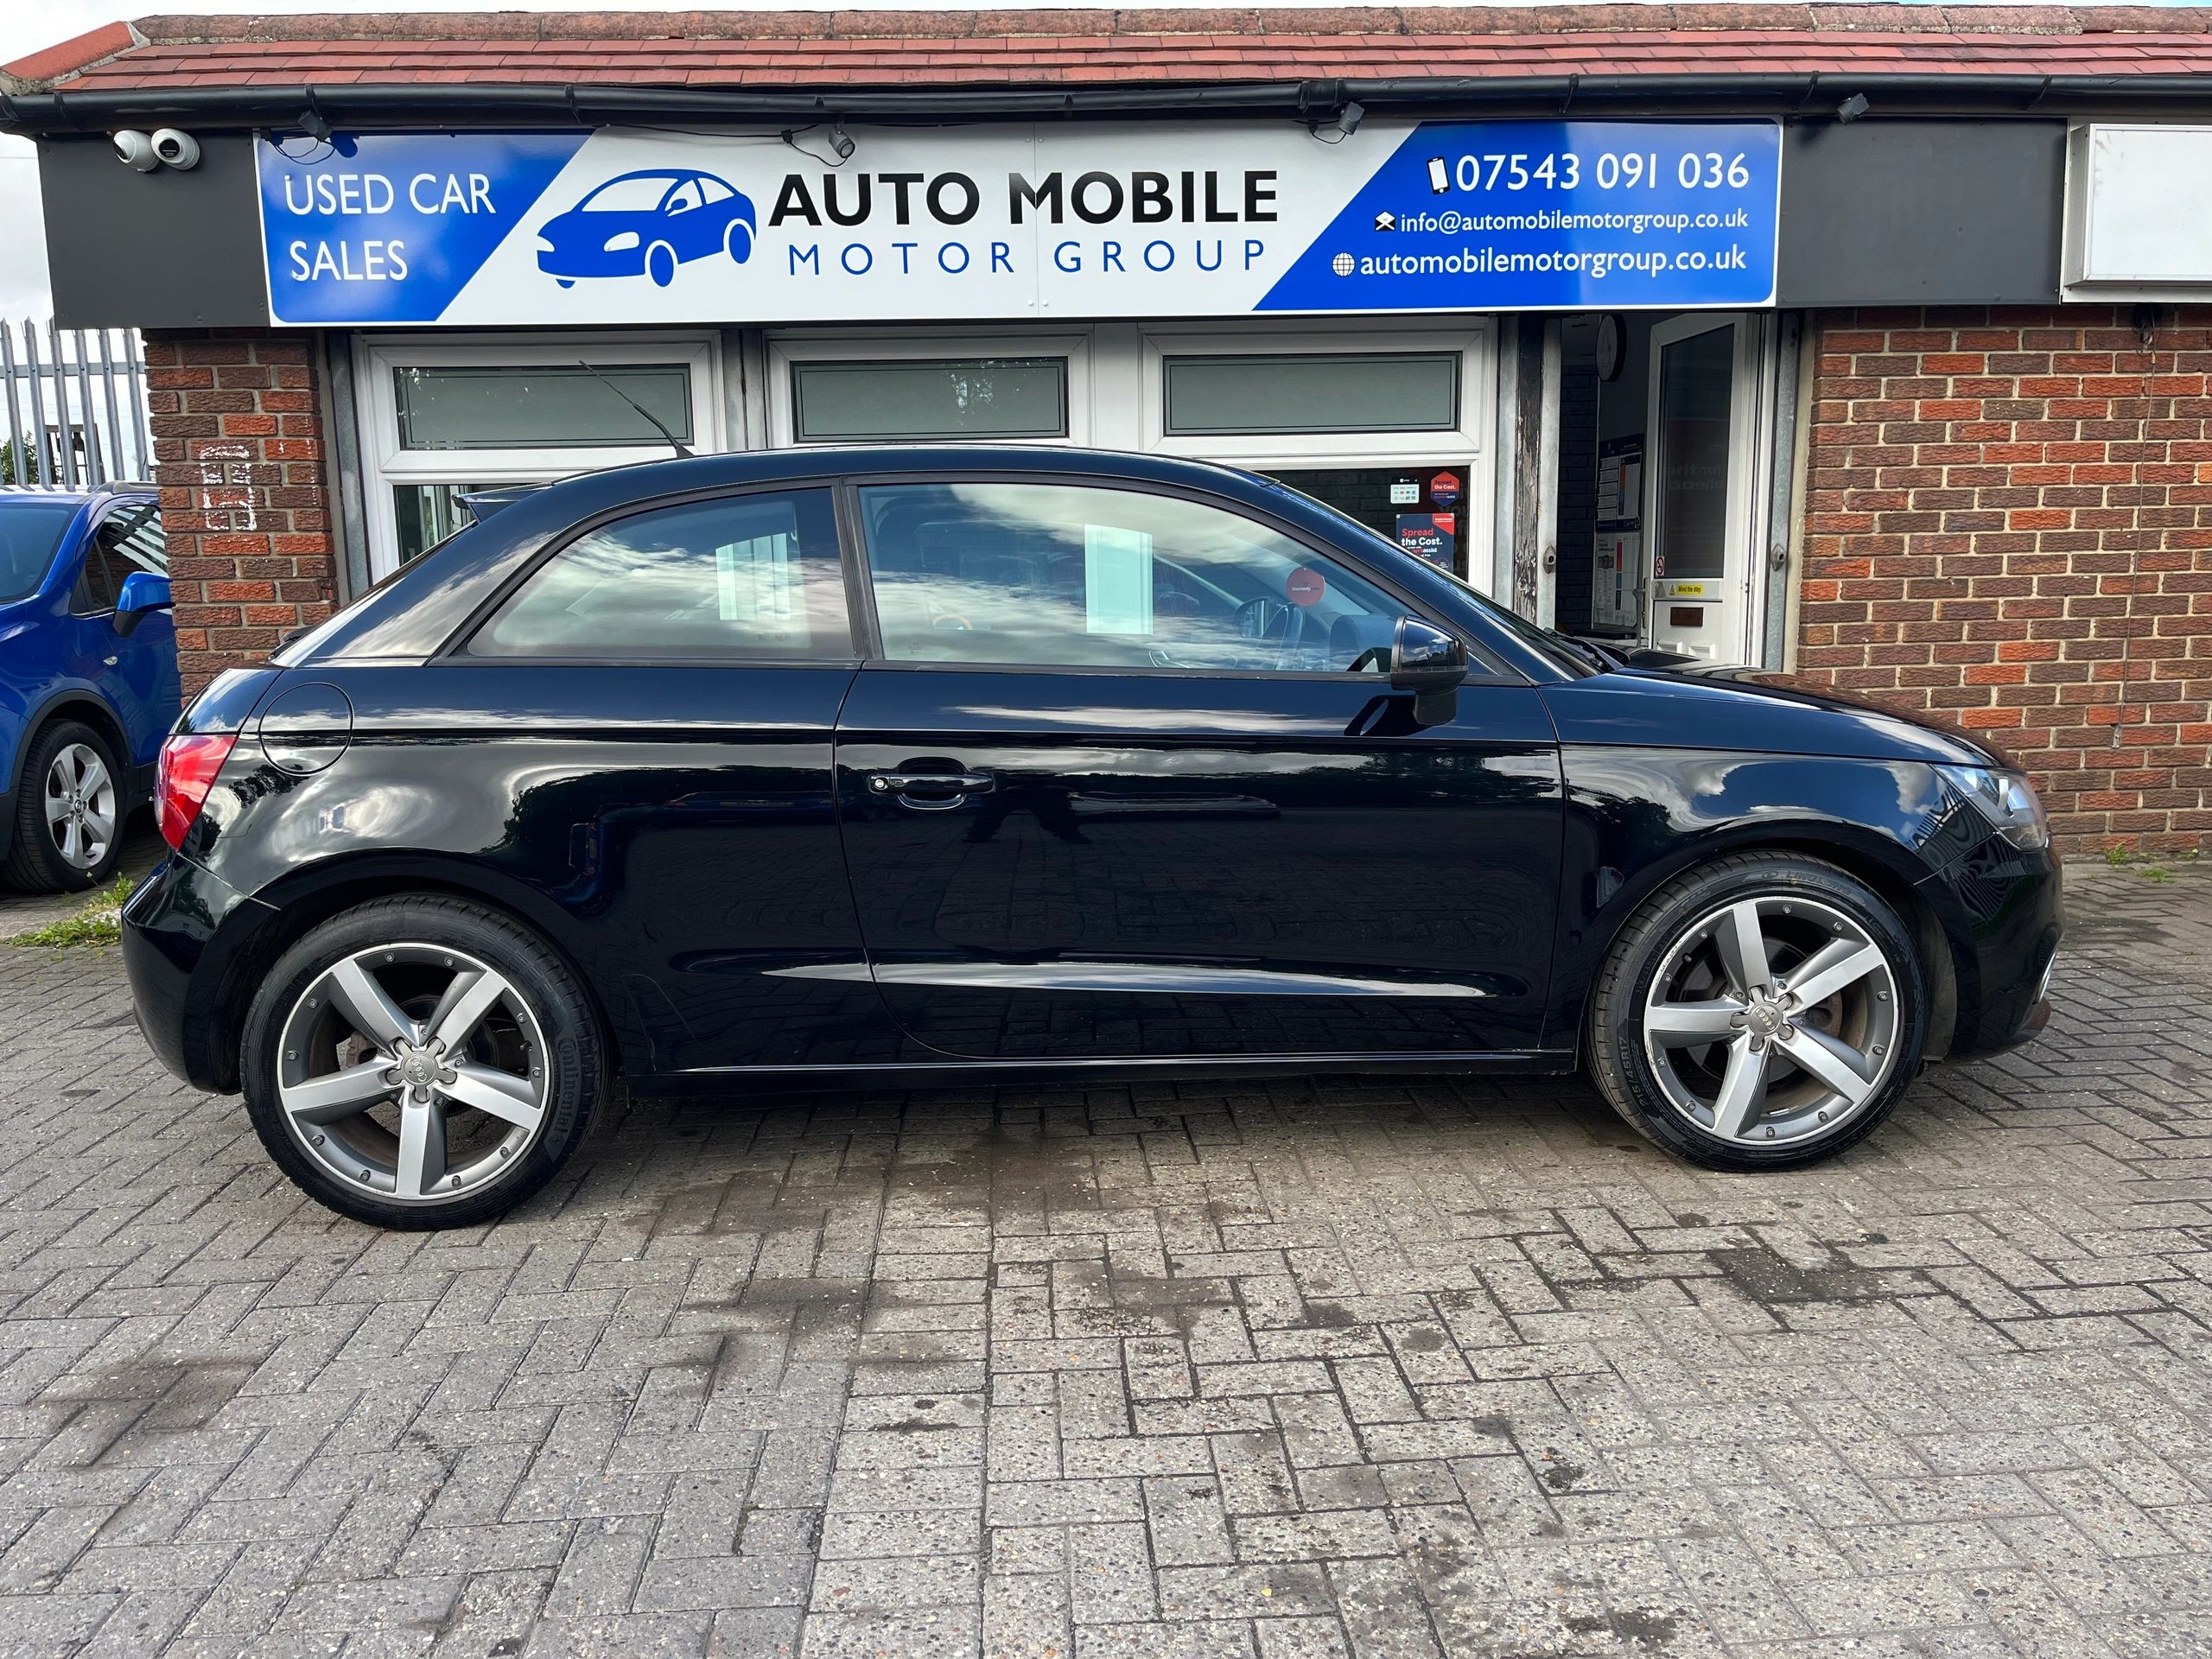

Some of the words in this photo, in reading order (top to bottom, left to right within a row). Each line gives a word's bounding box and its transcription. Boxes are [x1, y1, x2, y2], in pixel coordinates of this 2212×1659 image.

[1456, 153, 1580, 192] 07543
[1596, 152, 1656, 189] 091
[1678, 152, 1750, 189] 036
[284, 173, 395, 215] USED
[409, 173, 496, 214] CAR
[768, 171, 980, 226] AUTO
[1008, 170, 1278, 225] MOBILE
[1402, 207, 1749, 235] info@automobilemotorgroup.co.uk
[289, 238, 408, 282] SALES
[788, 241, 1014, 276] MOTOR
[1053, 239, 1264, 273] GROUP
[1360, 244, 1746, 278] automobilemotorgroup.co.uk
[1401, 537, 1417, 546] the
[1418, 537, 1443, 545] Cost.
[1402, 528, 1434, 537] Spread
[555, 1039, 579, 1133] Continental
[1618, 1036, 1648, 1108] 215/45R17
